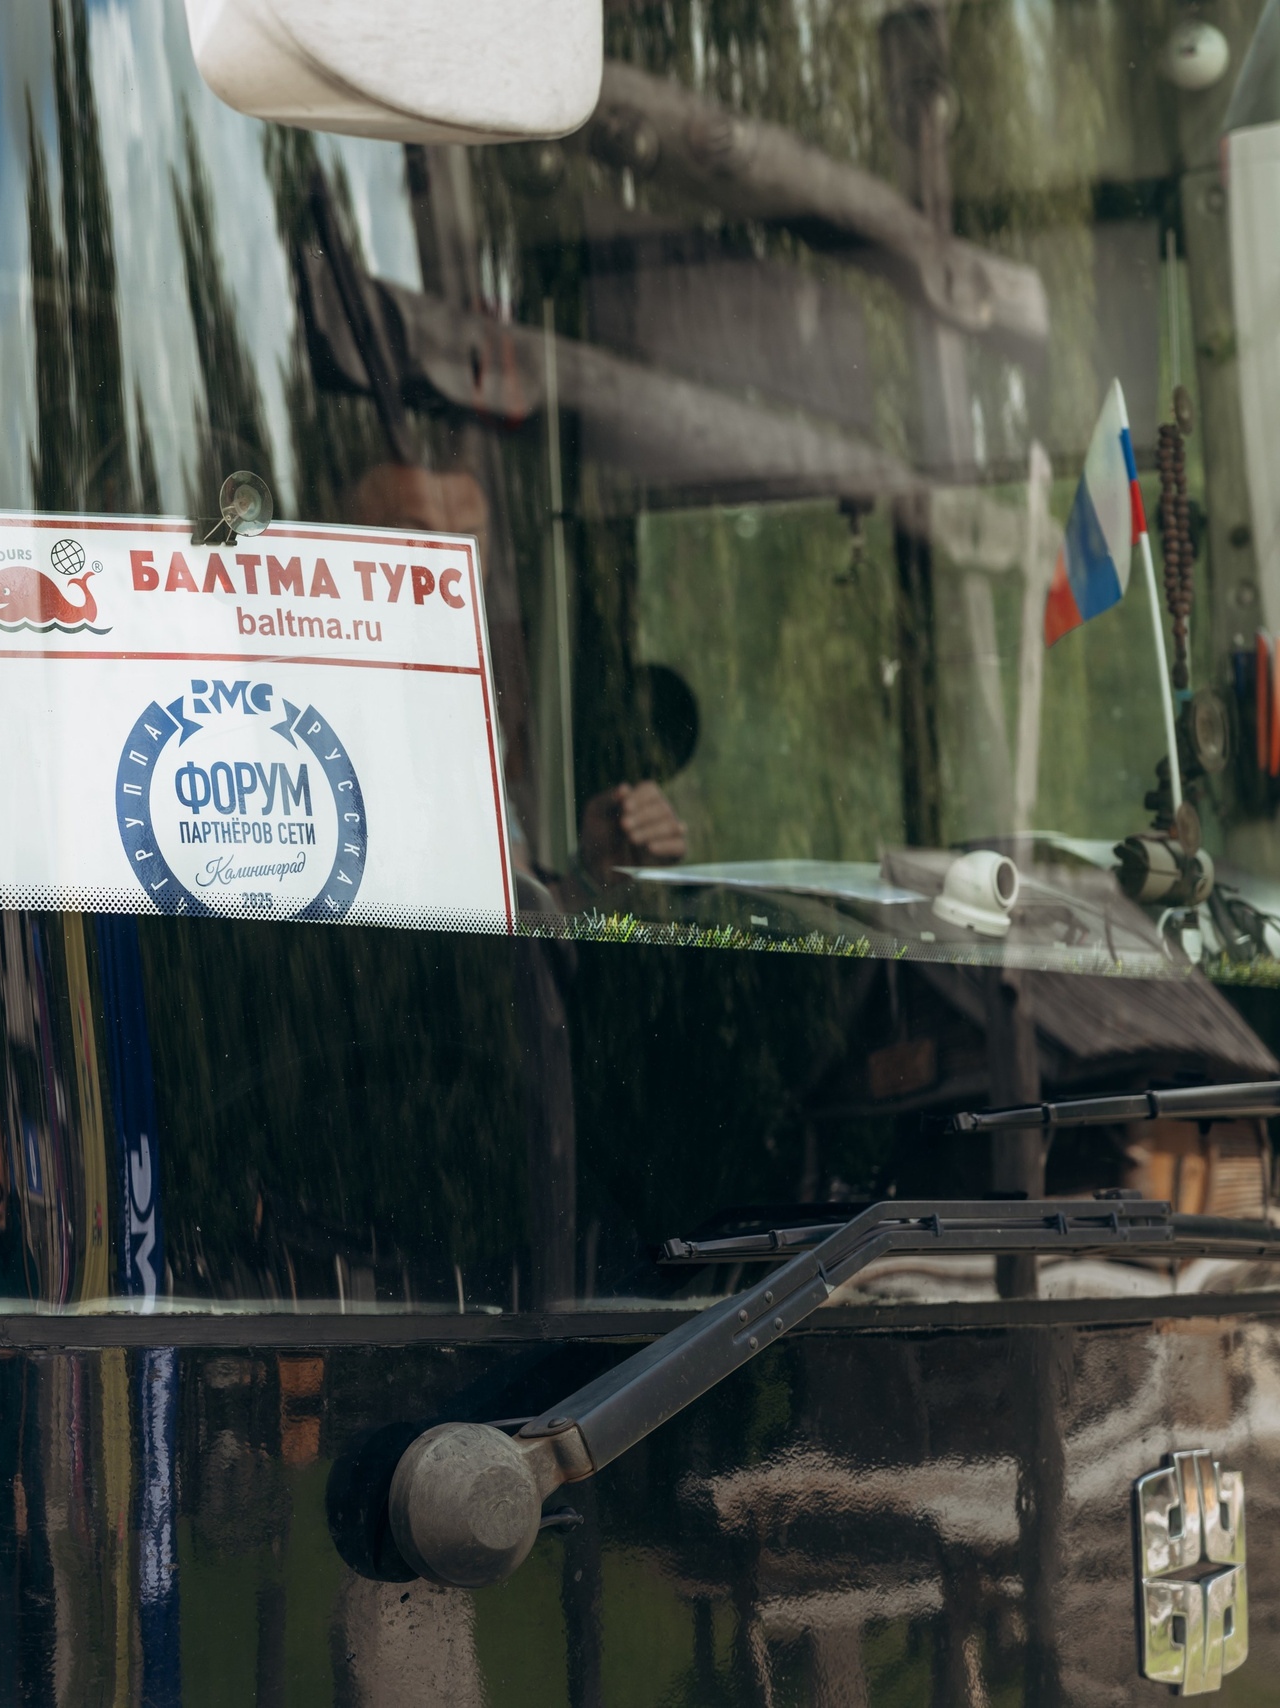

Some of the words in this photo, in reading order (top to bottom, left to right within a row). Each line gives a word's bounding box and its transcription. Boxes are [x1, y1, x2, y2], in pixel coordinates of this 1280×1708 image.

[129, 549, 341, 600] БАЛТМА
[352, 560, 466, 610] ТУРС
[235, 606, 383, 643] baltma.ru
[190, 679, 274, 715] RMG
[174, 761, 314, 817] ФОРУМ
[179, 817, 274, 845] ПАРТНЁРОВ
[277, 822, 317, 846] СЕТИ
[195, 851, 307, 888] Калининград
[241, 891, 274, 910] 2025
